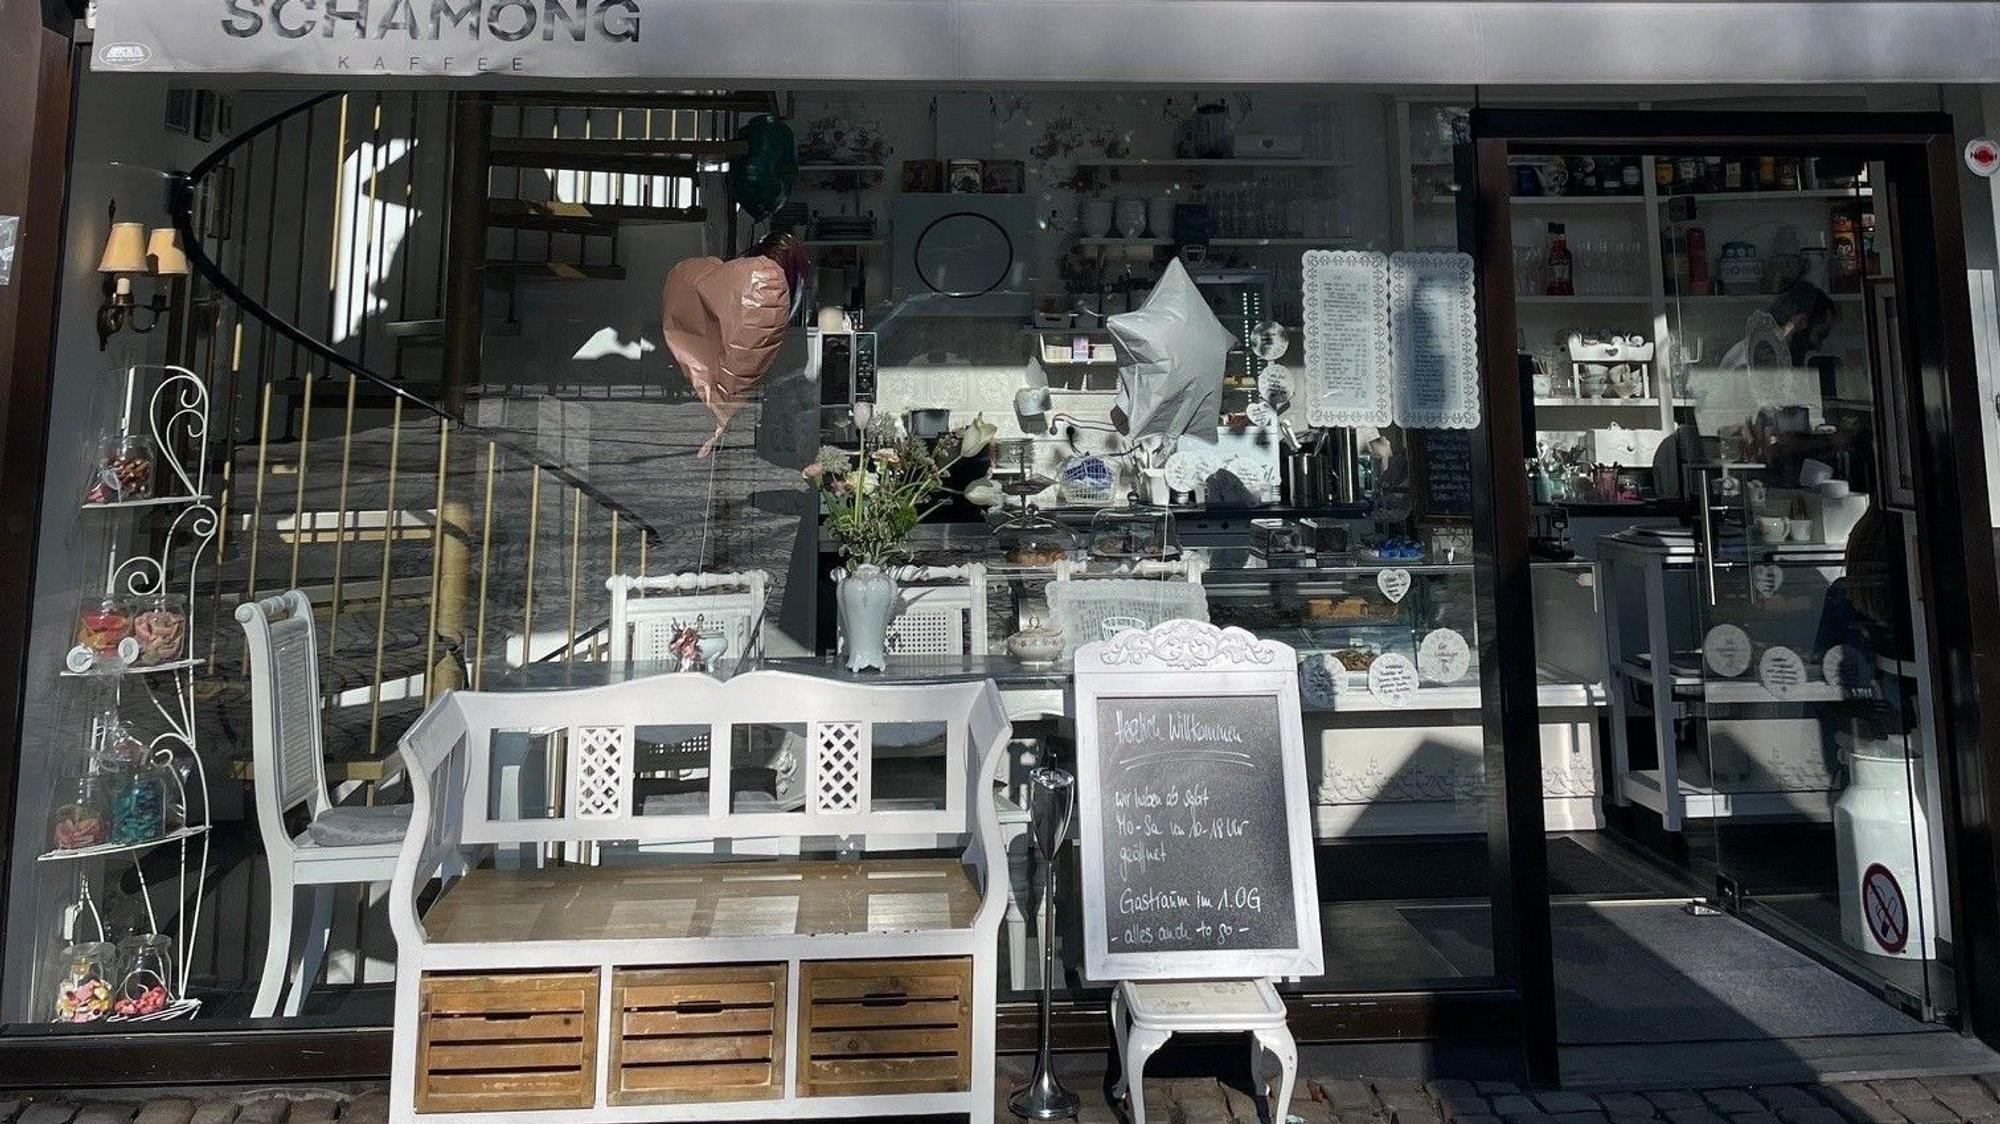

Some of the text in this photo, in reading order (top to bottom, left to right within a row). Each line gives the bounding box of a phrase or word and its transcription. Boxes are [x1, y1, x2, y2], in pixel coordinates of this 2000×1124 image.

[220, 0, 641, 43] SCHAMONG
[337, 55, 526, 73] KAFFEE
[1168, 711, 1242, 742] Willkommen
[1165, 784, 1179, 808] ab
[1197, 890, 1213, 910] im
